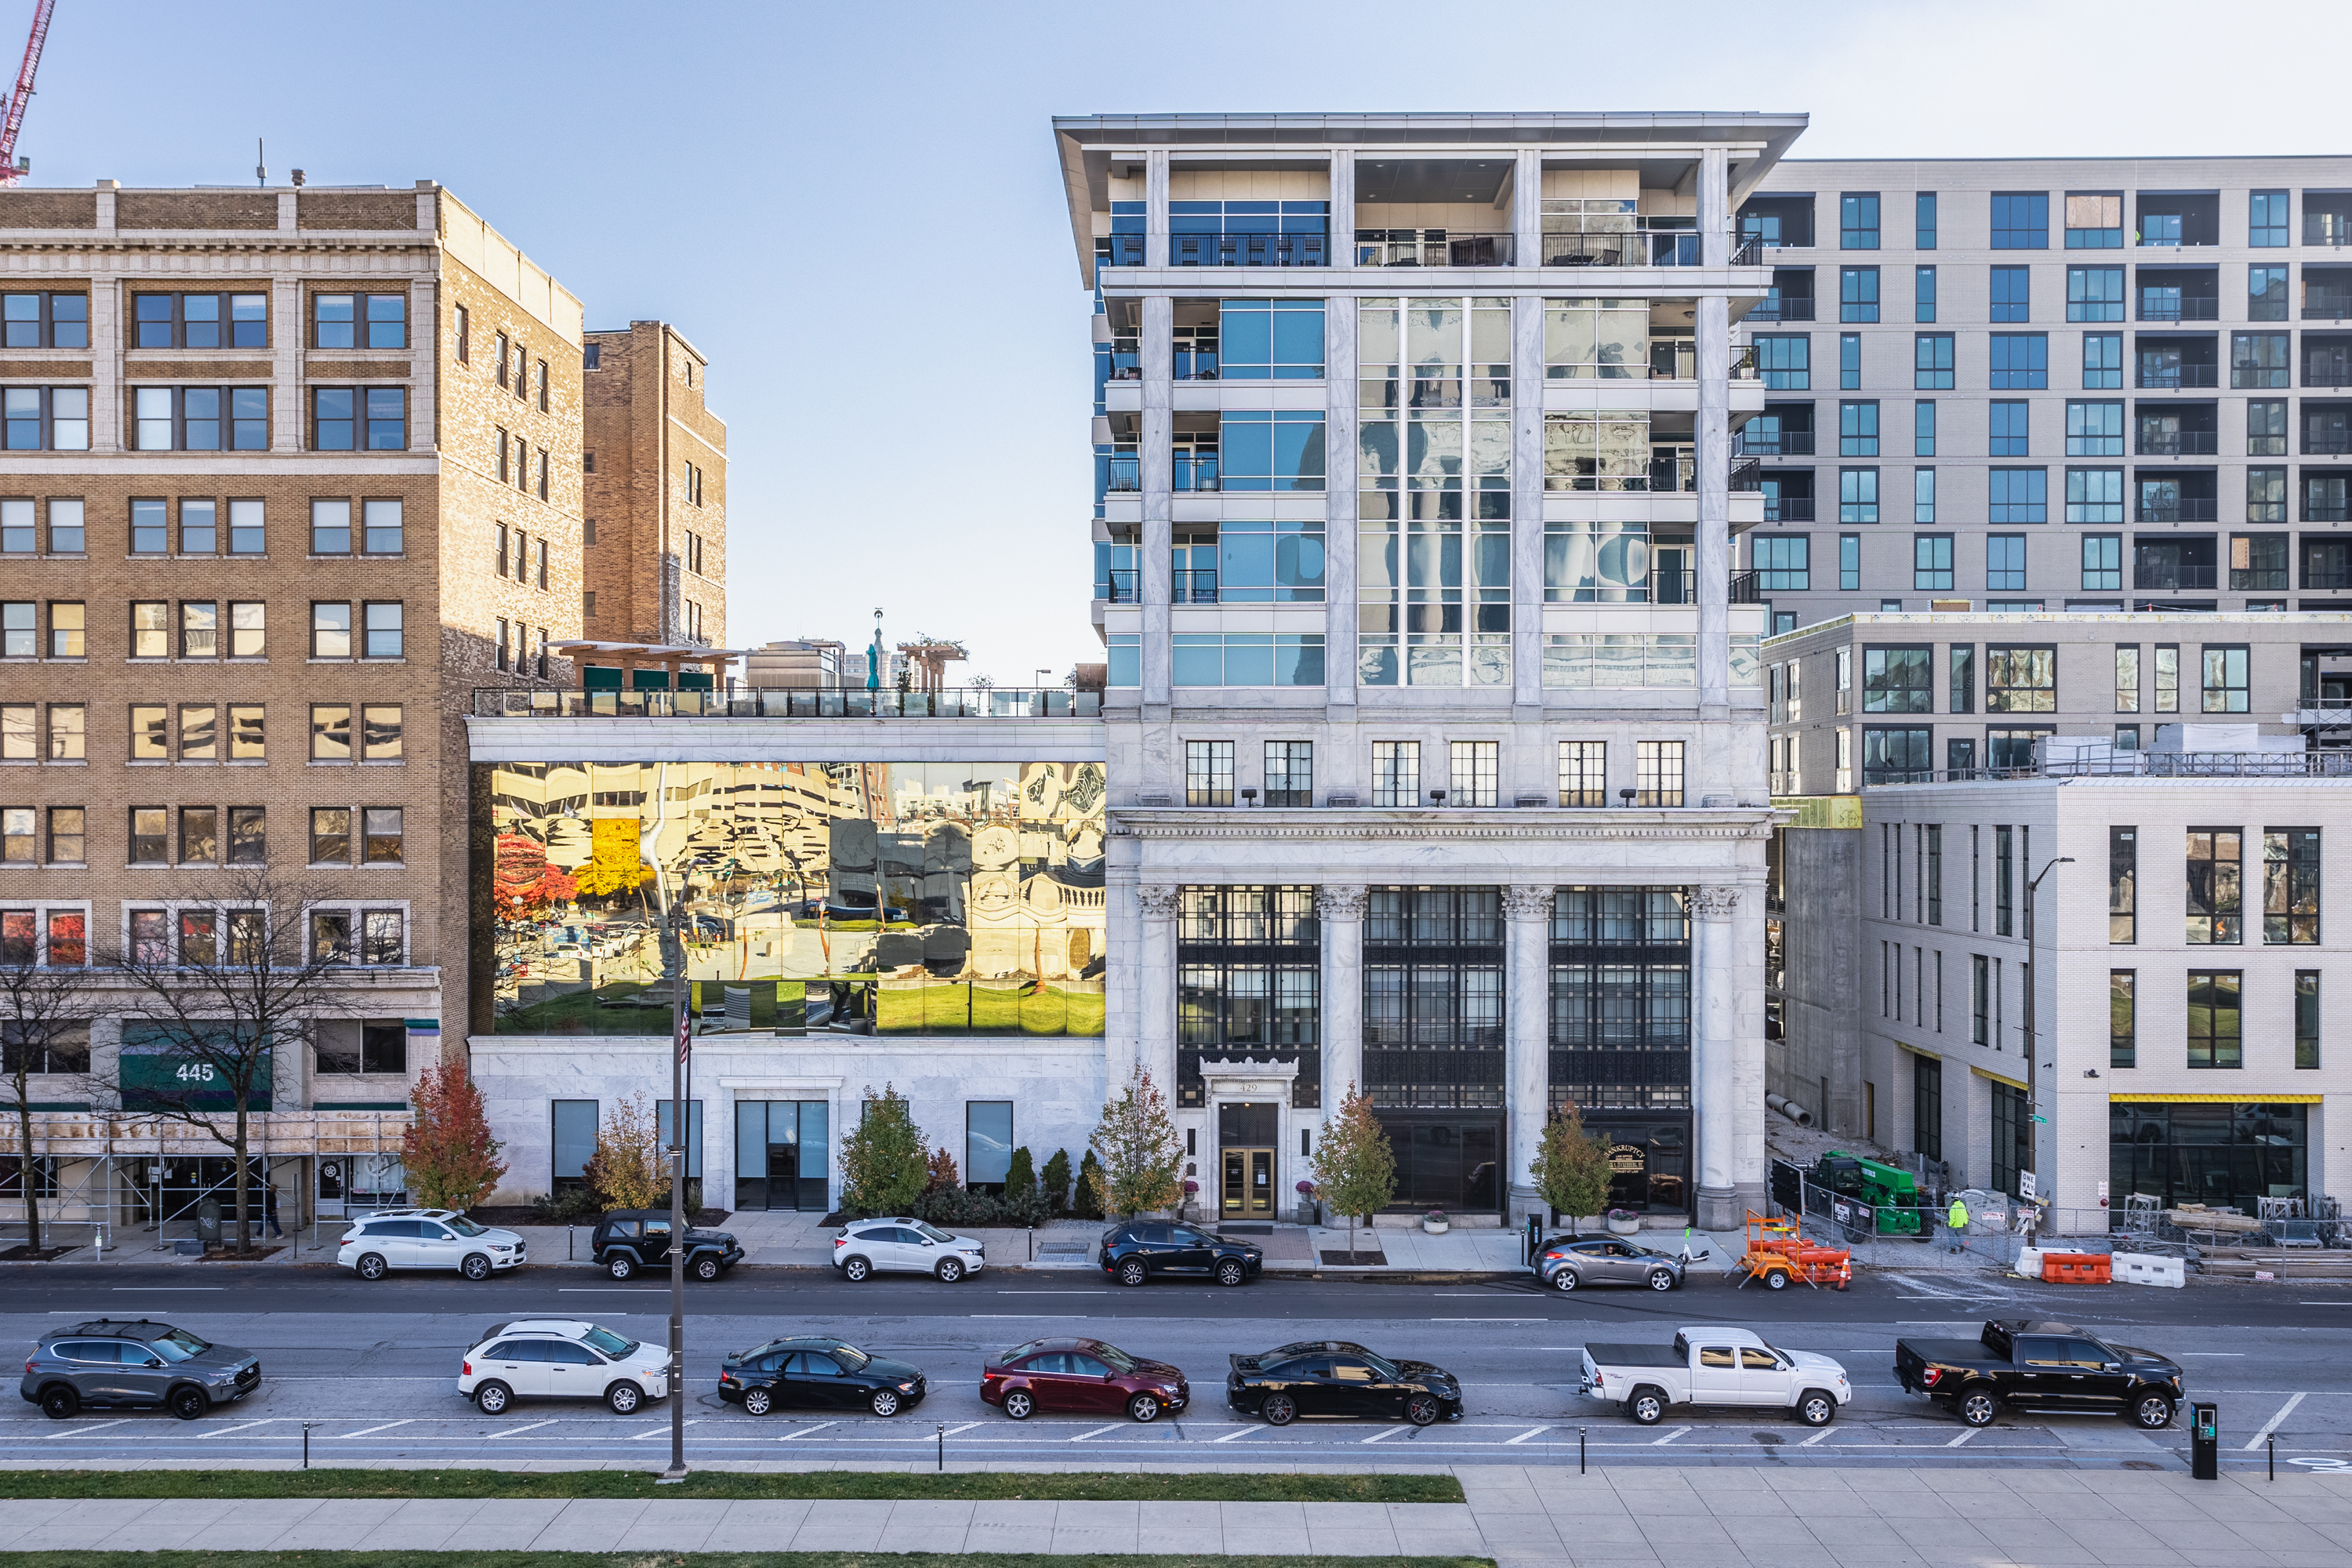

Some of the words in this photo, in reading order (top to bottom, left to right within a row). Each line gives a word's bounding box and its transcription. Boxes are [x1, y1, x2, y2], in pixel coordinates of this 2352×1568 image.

[176, 1064, 214, 1081] 445
[1240, 1083, 1258, 1092] 429
[1603, 1145, 1646, 1159] BANKRUPTCY
[2023, 1174, 2034, 1183] ONE
[2022, 1181, 2034, 1190] WAY
